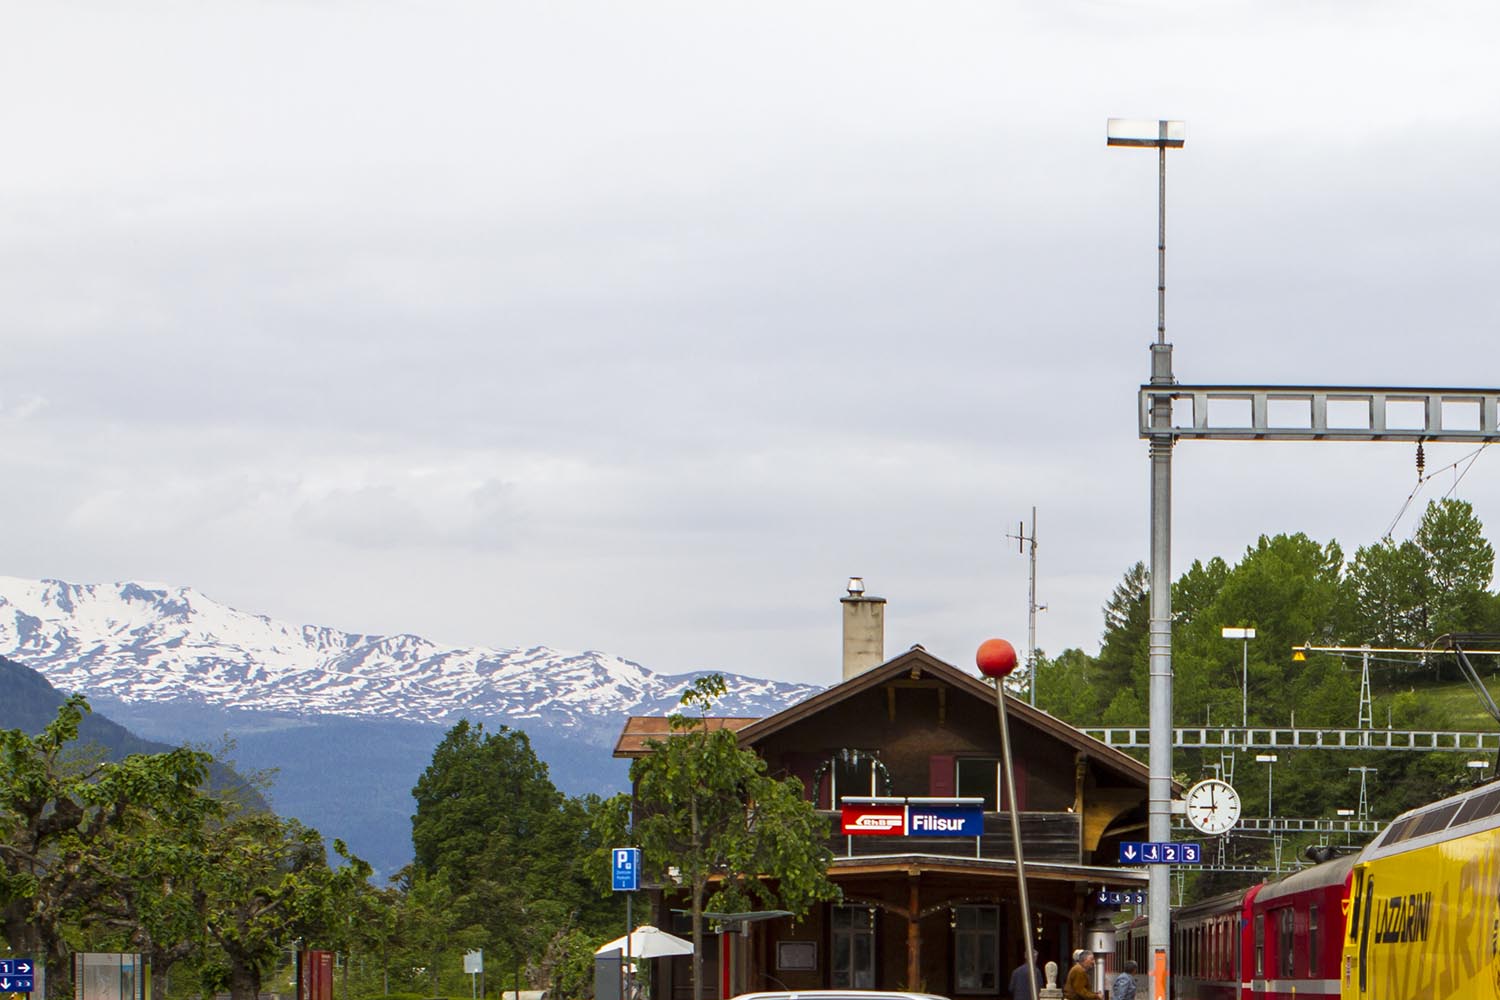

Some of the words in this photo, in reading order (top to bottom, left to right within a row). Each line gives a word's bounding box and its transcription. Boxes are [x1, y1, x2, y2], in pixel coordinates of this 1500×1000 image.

[912, 814, 966, 831] Filisur
[617, 850, 628, 869] P
[1166, 849, 1176, 860] 2
[1186, 850, 1195, 860] 3
[1124, 895, 1131, 903] 2
[1136, 895, 1143, 903] 3
[1375, 892, 1431, 944] LAZZARINI
[3, 964, 9, 973] 1
